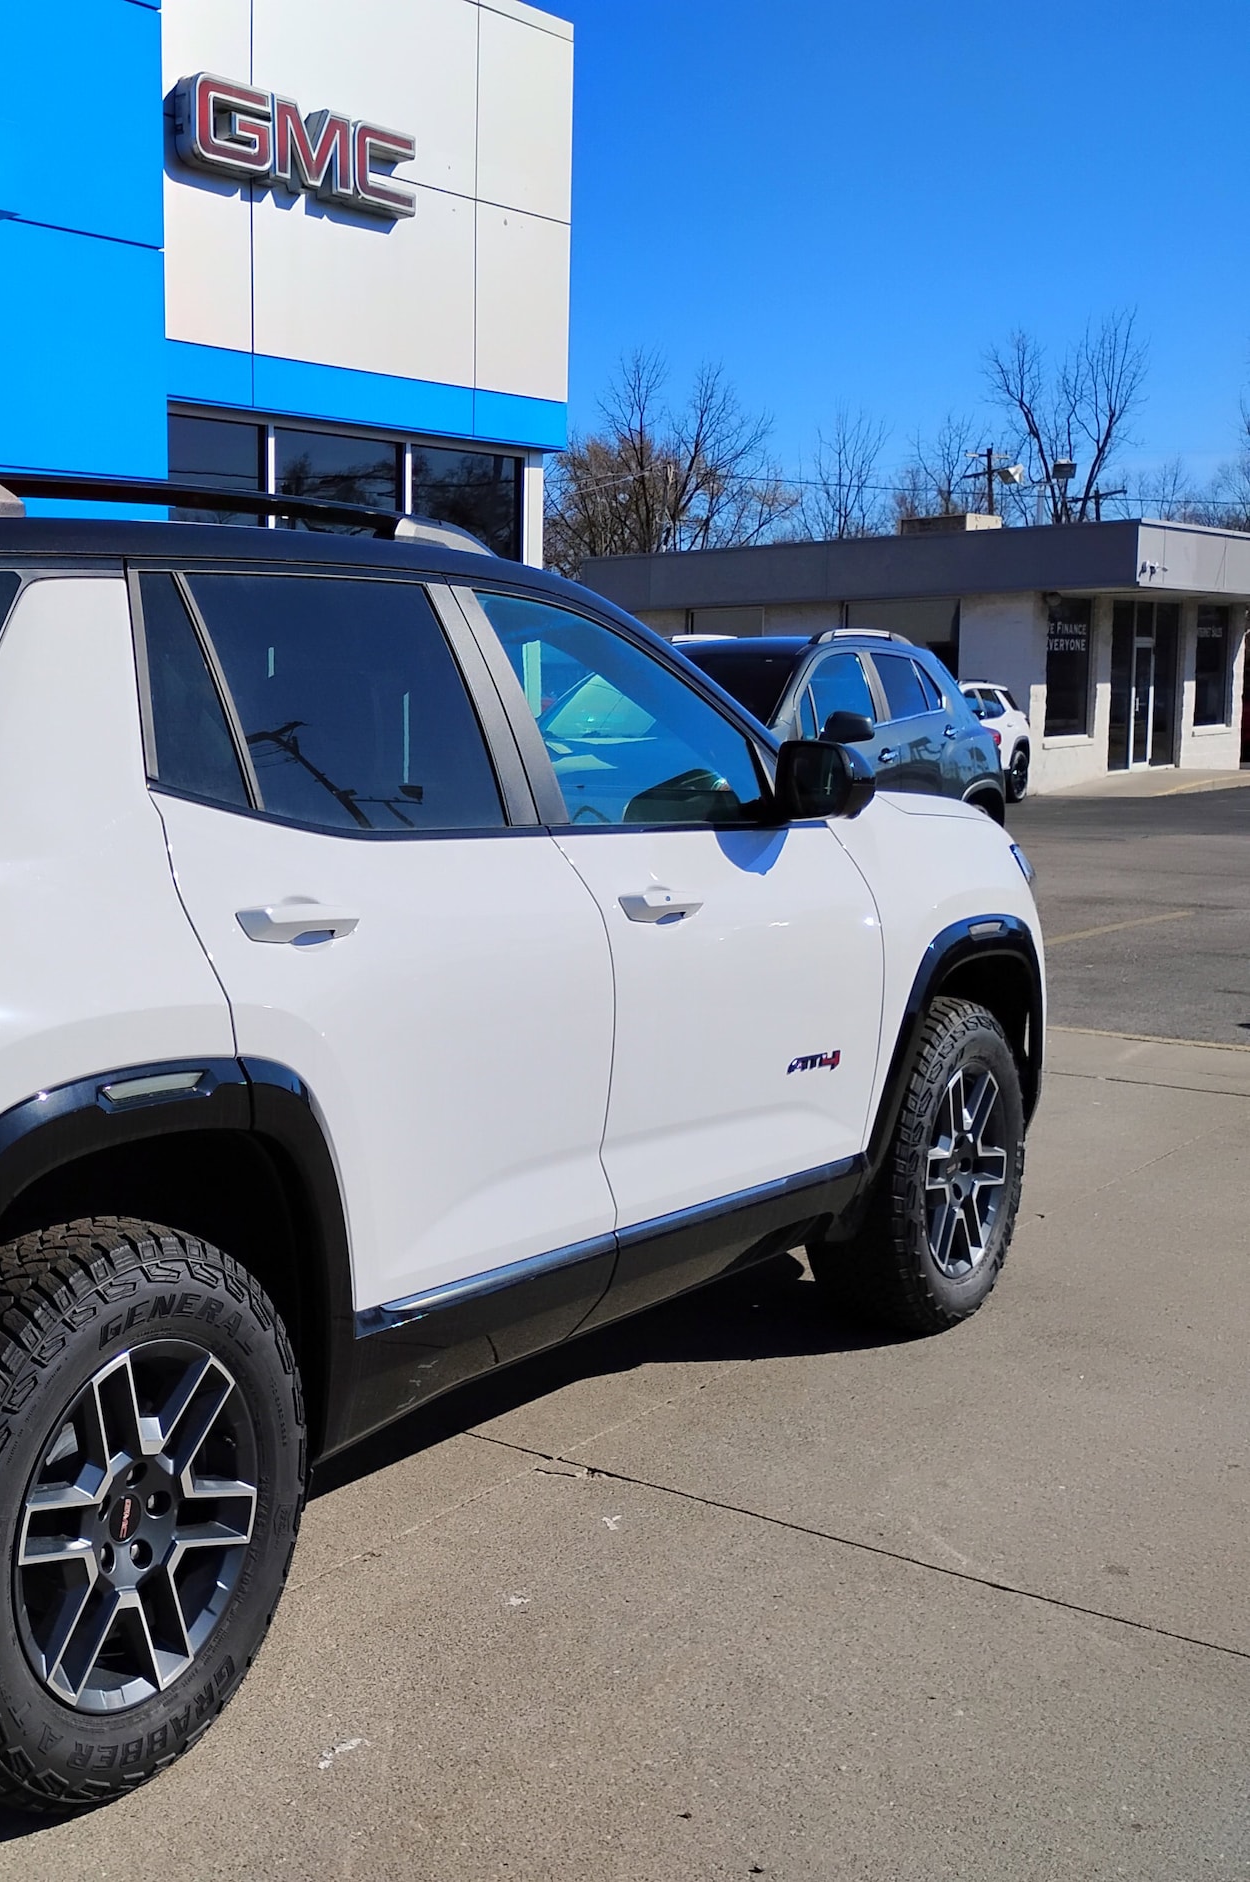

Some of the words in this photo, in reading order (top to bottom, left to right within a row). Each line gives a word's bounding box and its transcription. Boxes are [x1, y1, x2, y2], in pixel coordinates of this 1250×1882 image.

[193, 72, 416, 218] GMC
[1056, 621, 1087, 635] FINANCE
[786, 1049, 841, 1075] AT4
[99, 1291, 256, 1357] GENERAL
[66, 1655, 237, 1773] GRABBER
